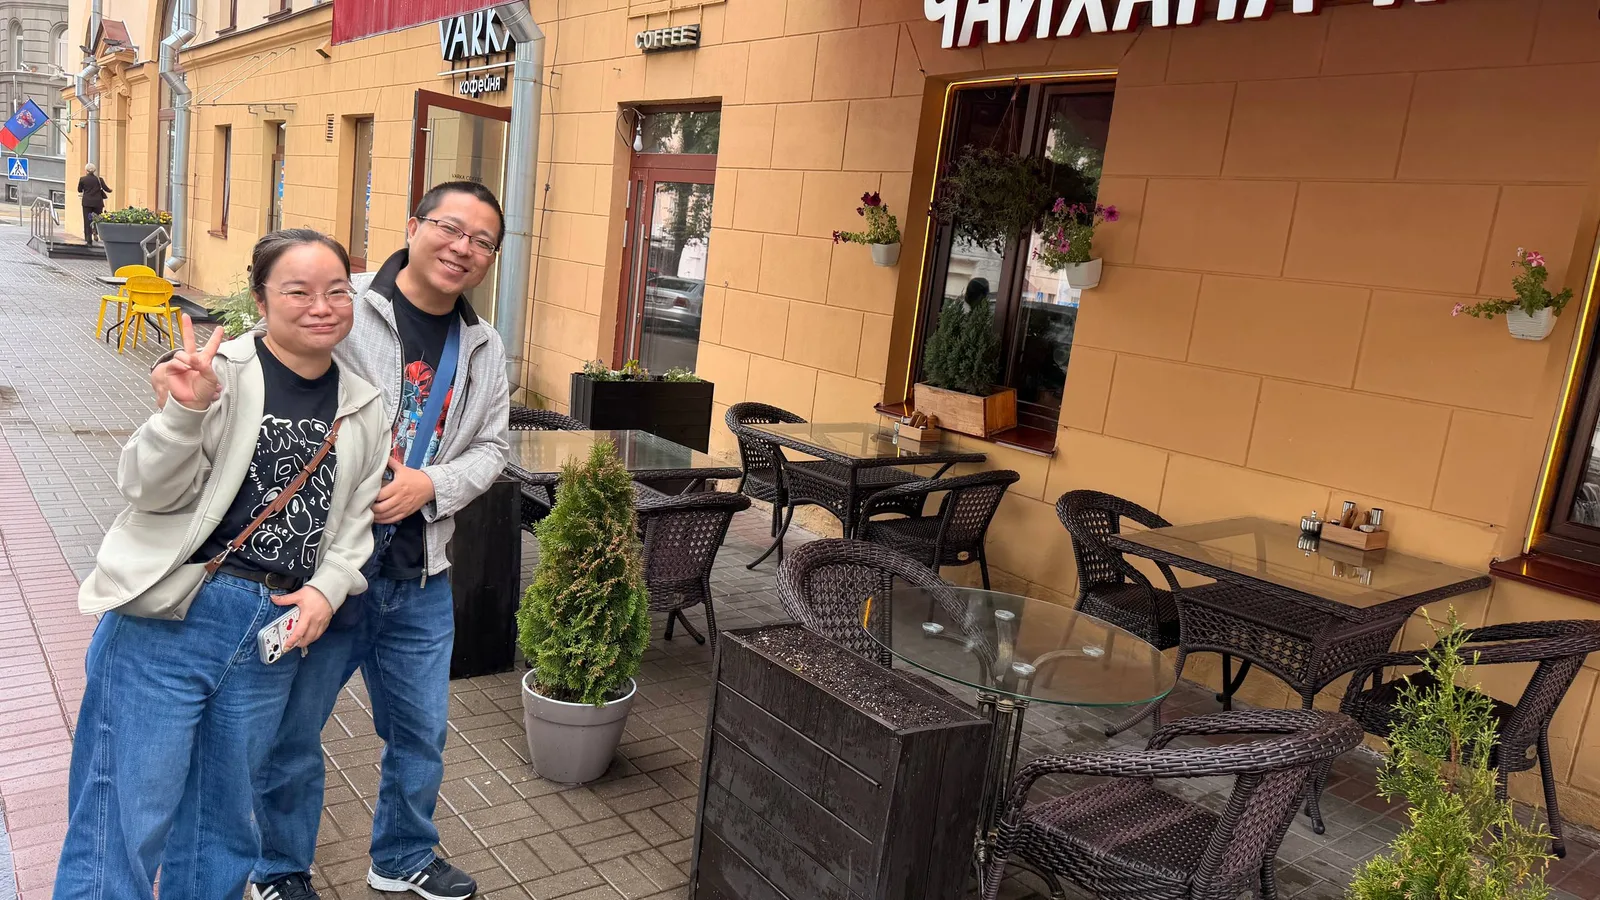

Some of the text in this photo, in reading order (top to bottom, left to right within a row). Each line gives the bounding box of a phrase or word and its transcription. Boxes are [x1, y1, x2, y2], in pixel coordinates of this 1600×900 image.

[635, 25, 691, 49] COFFEE
[459, 73, 501, 98] кофейня
[258, 523, 294, 543] ickey
